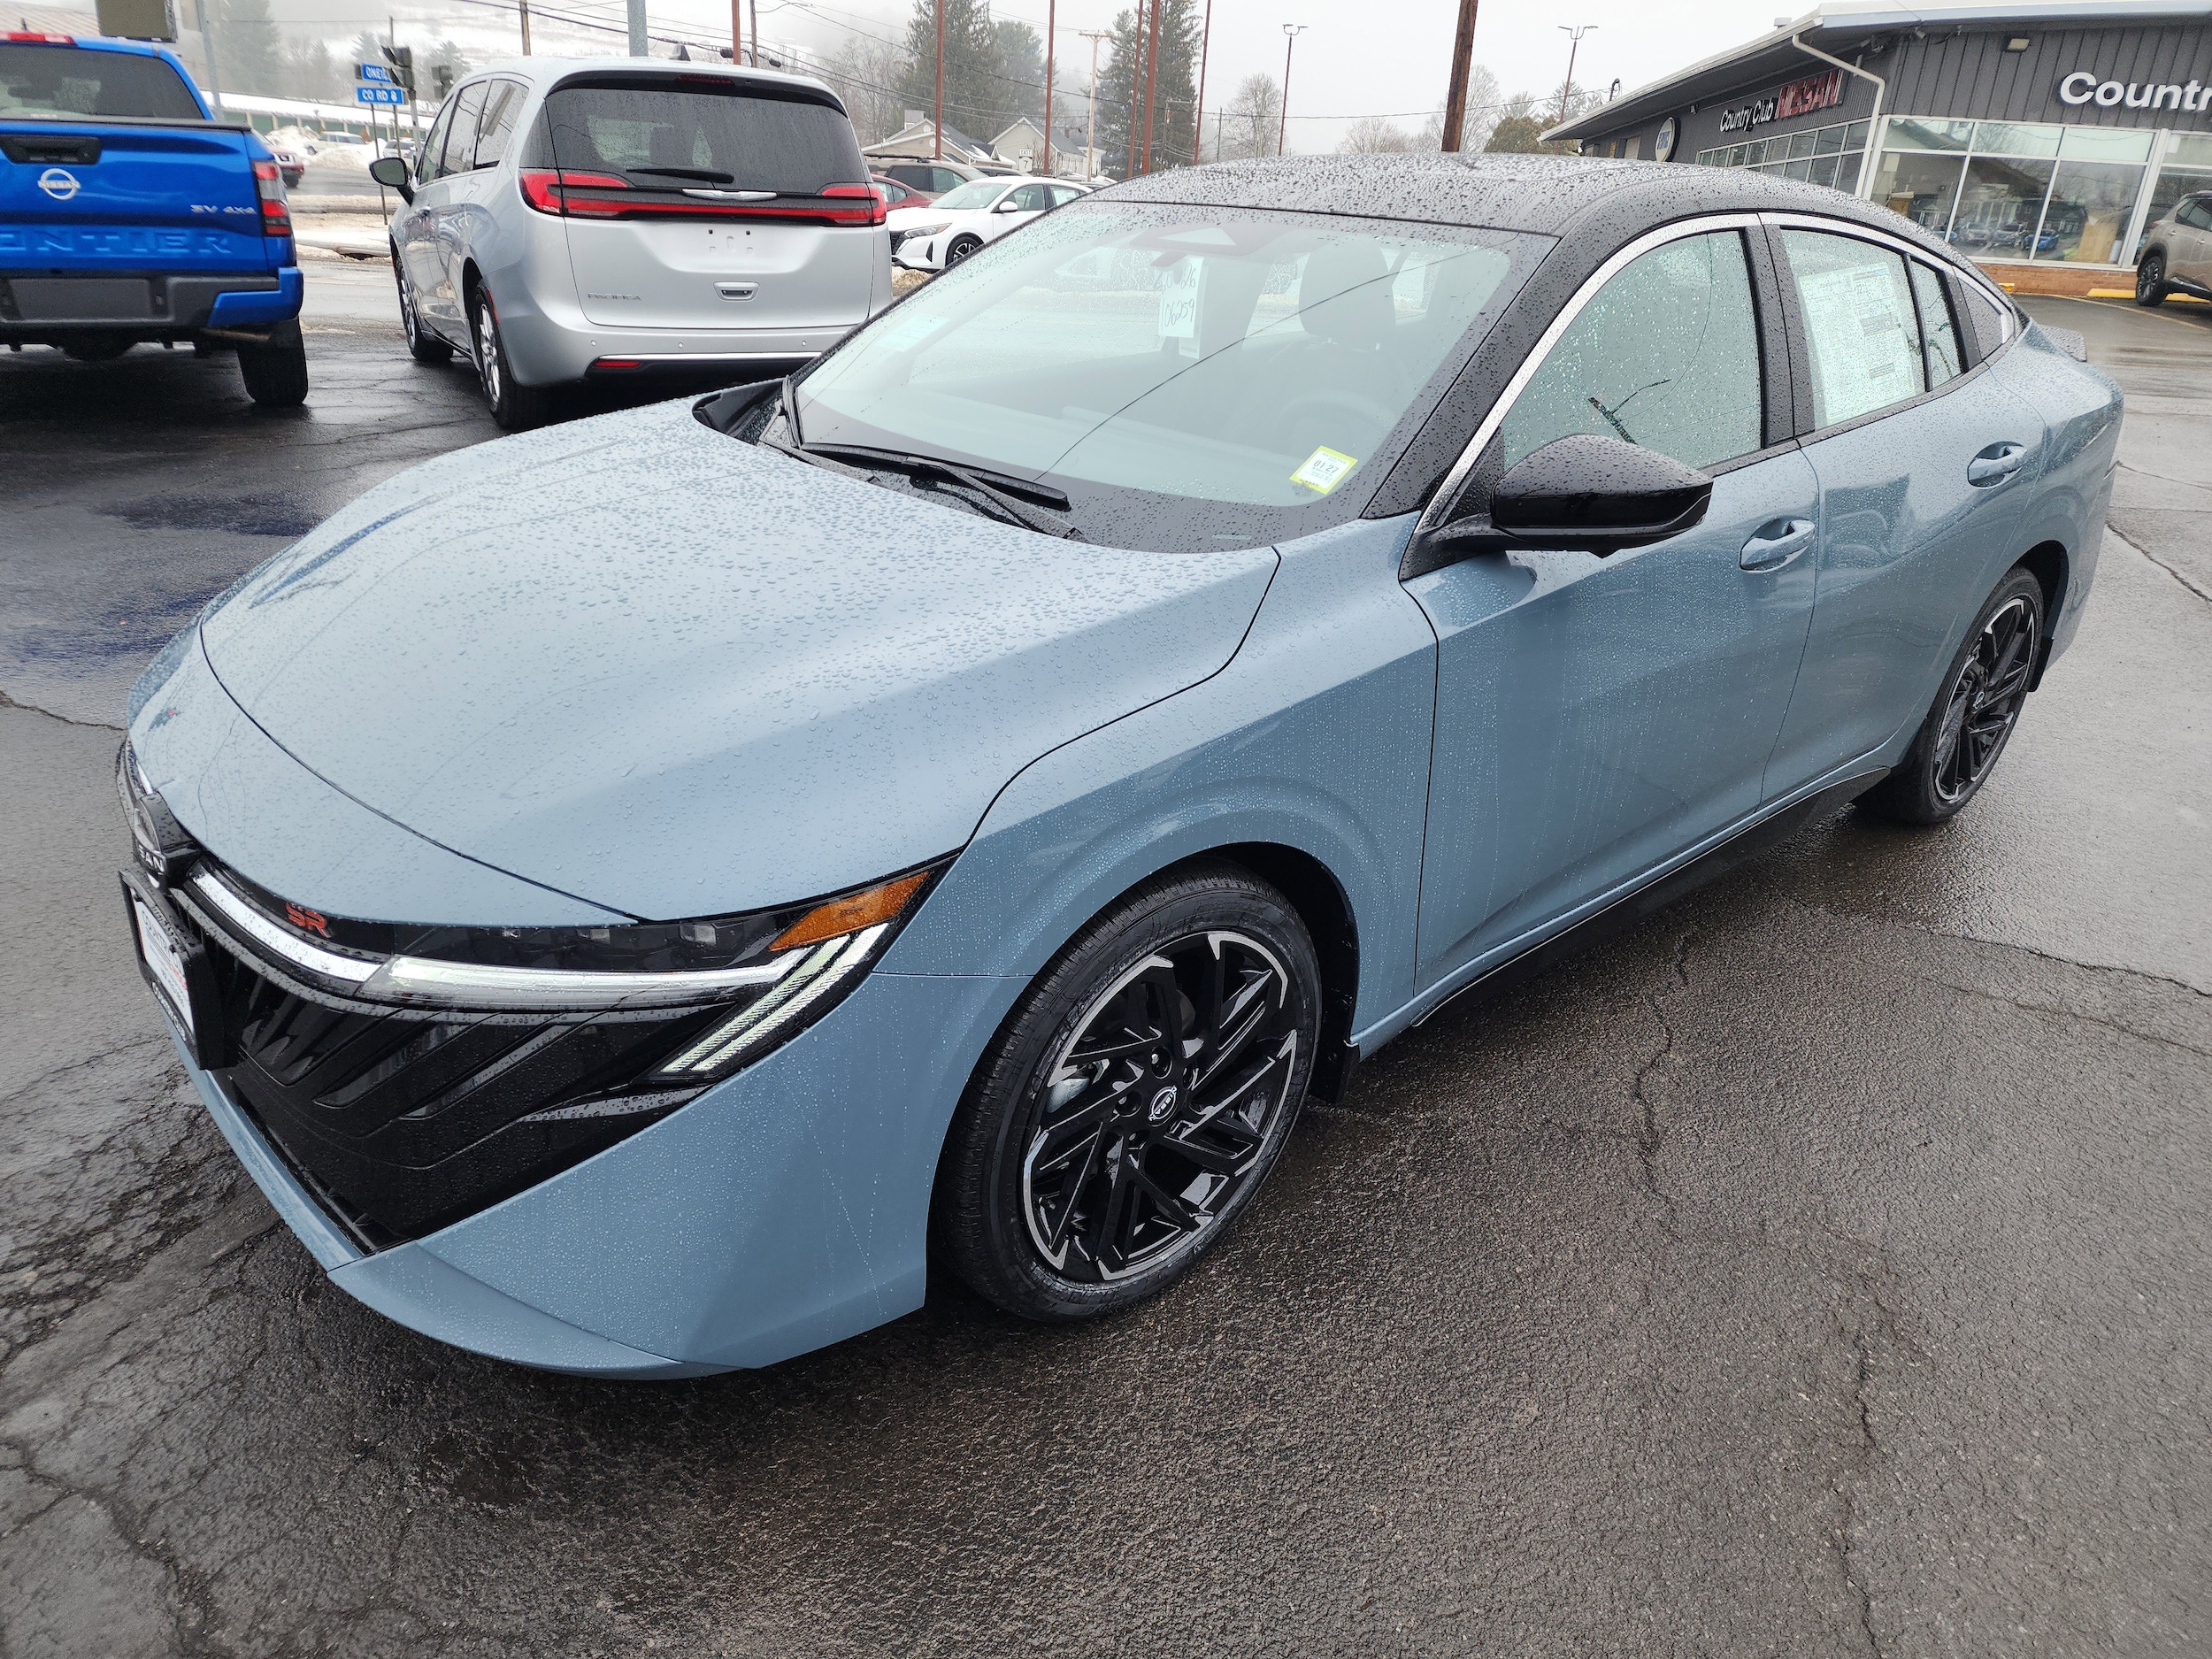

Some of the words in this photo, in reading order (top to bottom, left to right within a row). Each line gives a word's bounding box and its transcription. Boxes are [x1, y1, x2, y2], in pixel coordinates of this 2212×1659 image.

[362, 88, 375, 102] CO
[376, 89, 389, 102] RD
[1720, 106, 1753, 132] Country
[1753, 97, 1774, 124] Club
[1775, 68, 1843, 119] NISSAN
[190, 204, 219, 214] SV
[588, 292, 641, 301] PACIFICA
[285, 902, 332, 938] SR
